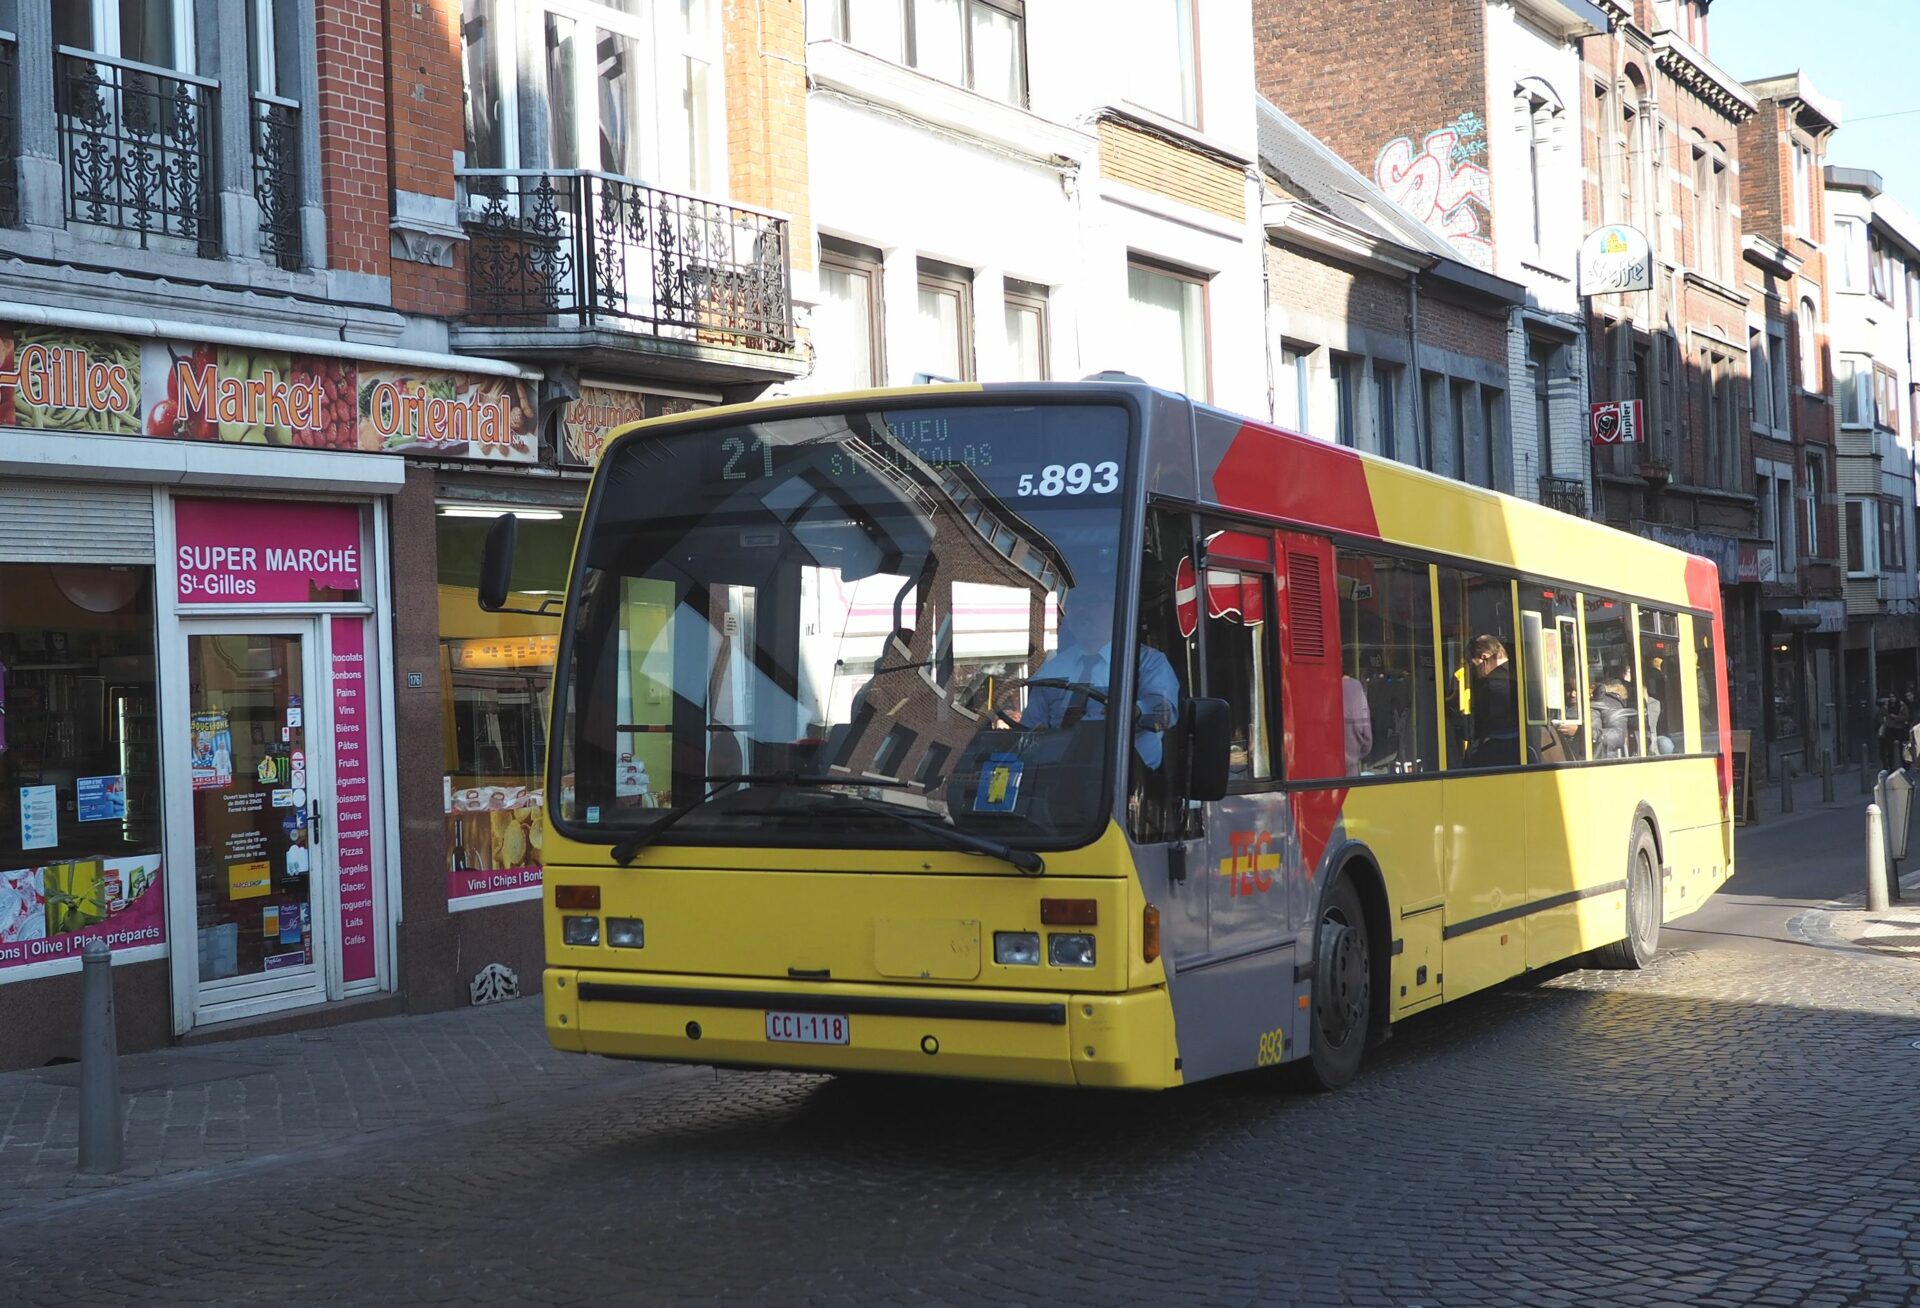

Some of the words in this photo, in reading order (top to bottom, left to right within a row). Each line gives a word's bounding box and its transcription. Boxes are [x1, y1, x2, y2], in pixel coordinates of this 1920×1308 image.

[177, 361, 324, 429] Market
[371, 382, 511, 444] Oriental
[1623, 402, 1633, 439] Jupiler
[721, 434, 774, 480] 21
[1017, 460, 1120, 497] 5.893
[179, 545, 257, 571] SUPER
[265, 544, 358, 573] MARCHÉ
[180, 573, 257, 595] St-Gilles
[332, 653, 363, 662] hocolats
[336, 688, 357, 697] Pains
[338, 706, 355, 715] Vins
[336, 724, 360, 733] Bières
[338, 741, 359, 750] Pâtes
[338, 759, 359, 768] Fruits
[336, 775, 366, 787] égumes
[339, 812, 362, 821] Olives
[338, 829, 369, 840] romages
[340, 847, 364, 857] Pizzas
[1228, 831, 1273, 897] TEC
[467, 878, 487, 891] Vins
[493, 874, 517, 887] Chips
[341, 898, 372, 911] roguerie
[345, 917, 364, 927] Laits
[31, 939, 63, 956] Olive
[106, 925, 160, 945] préparés
[344, 935, 366, 945] Cafés
[1257, 1027, 1283, 1067] 893
